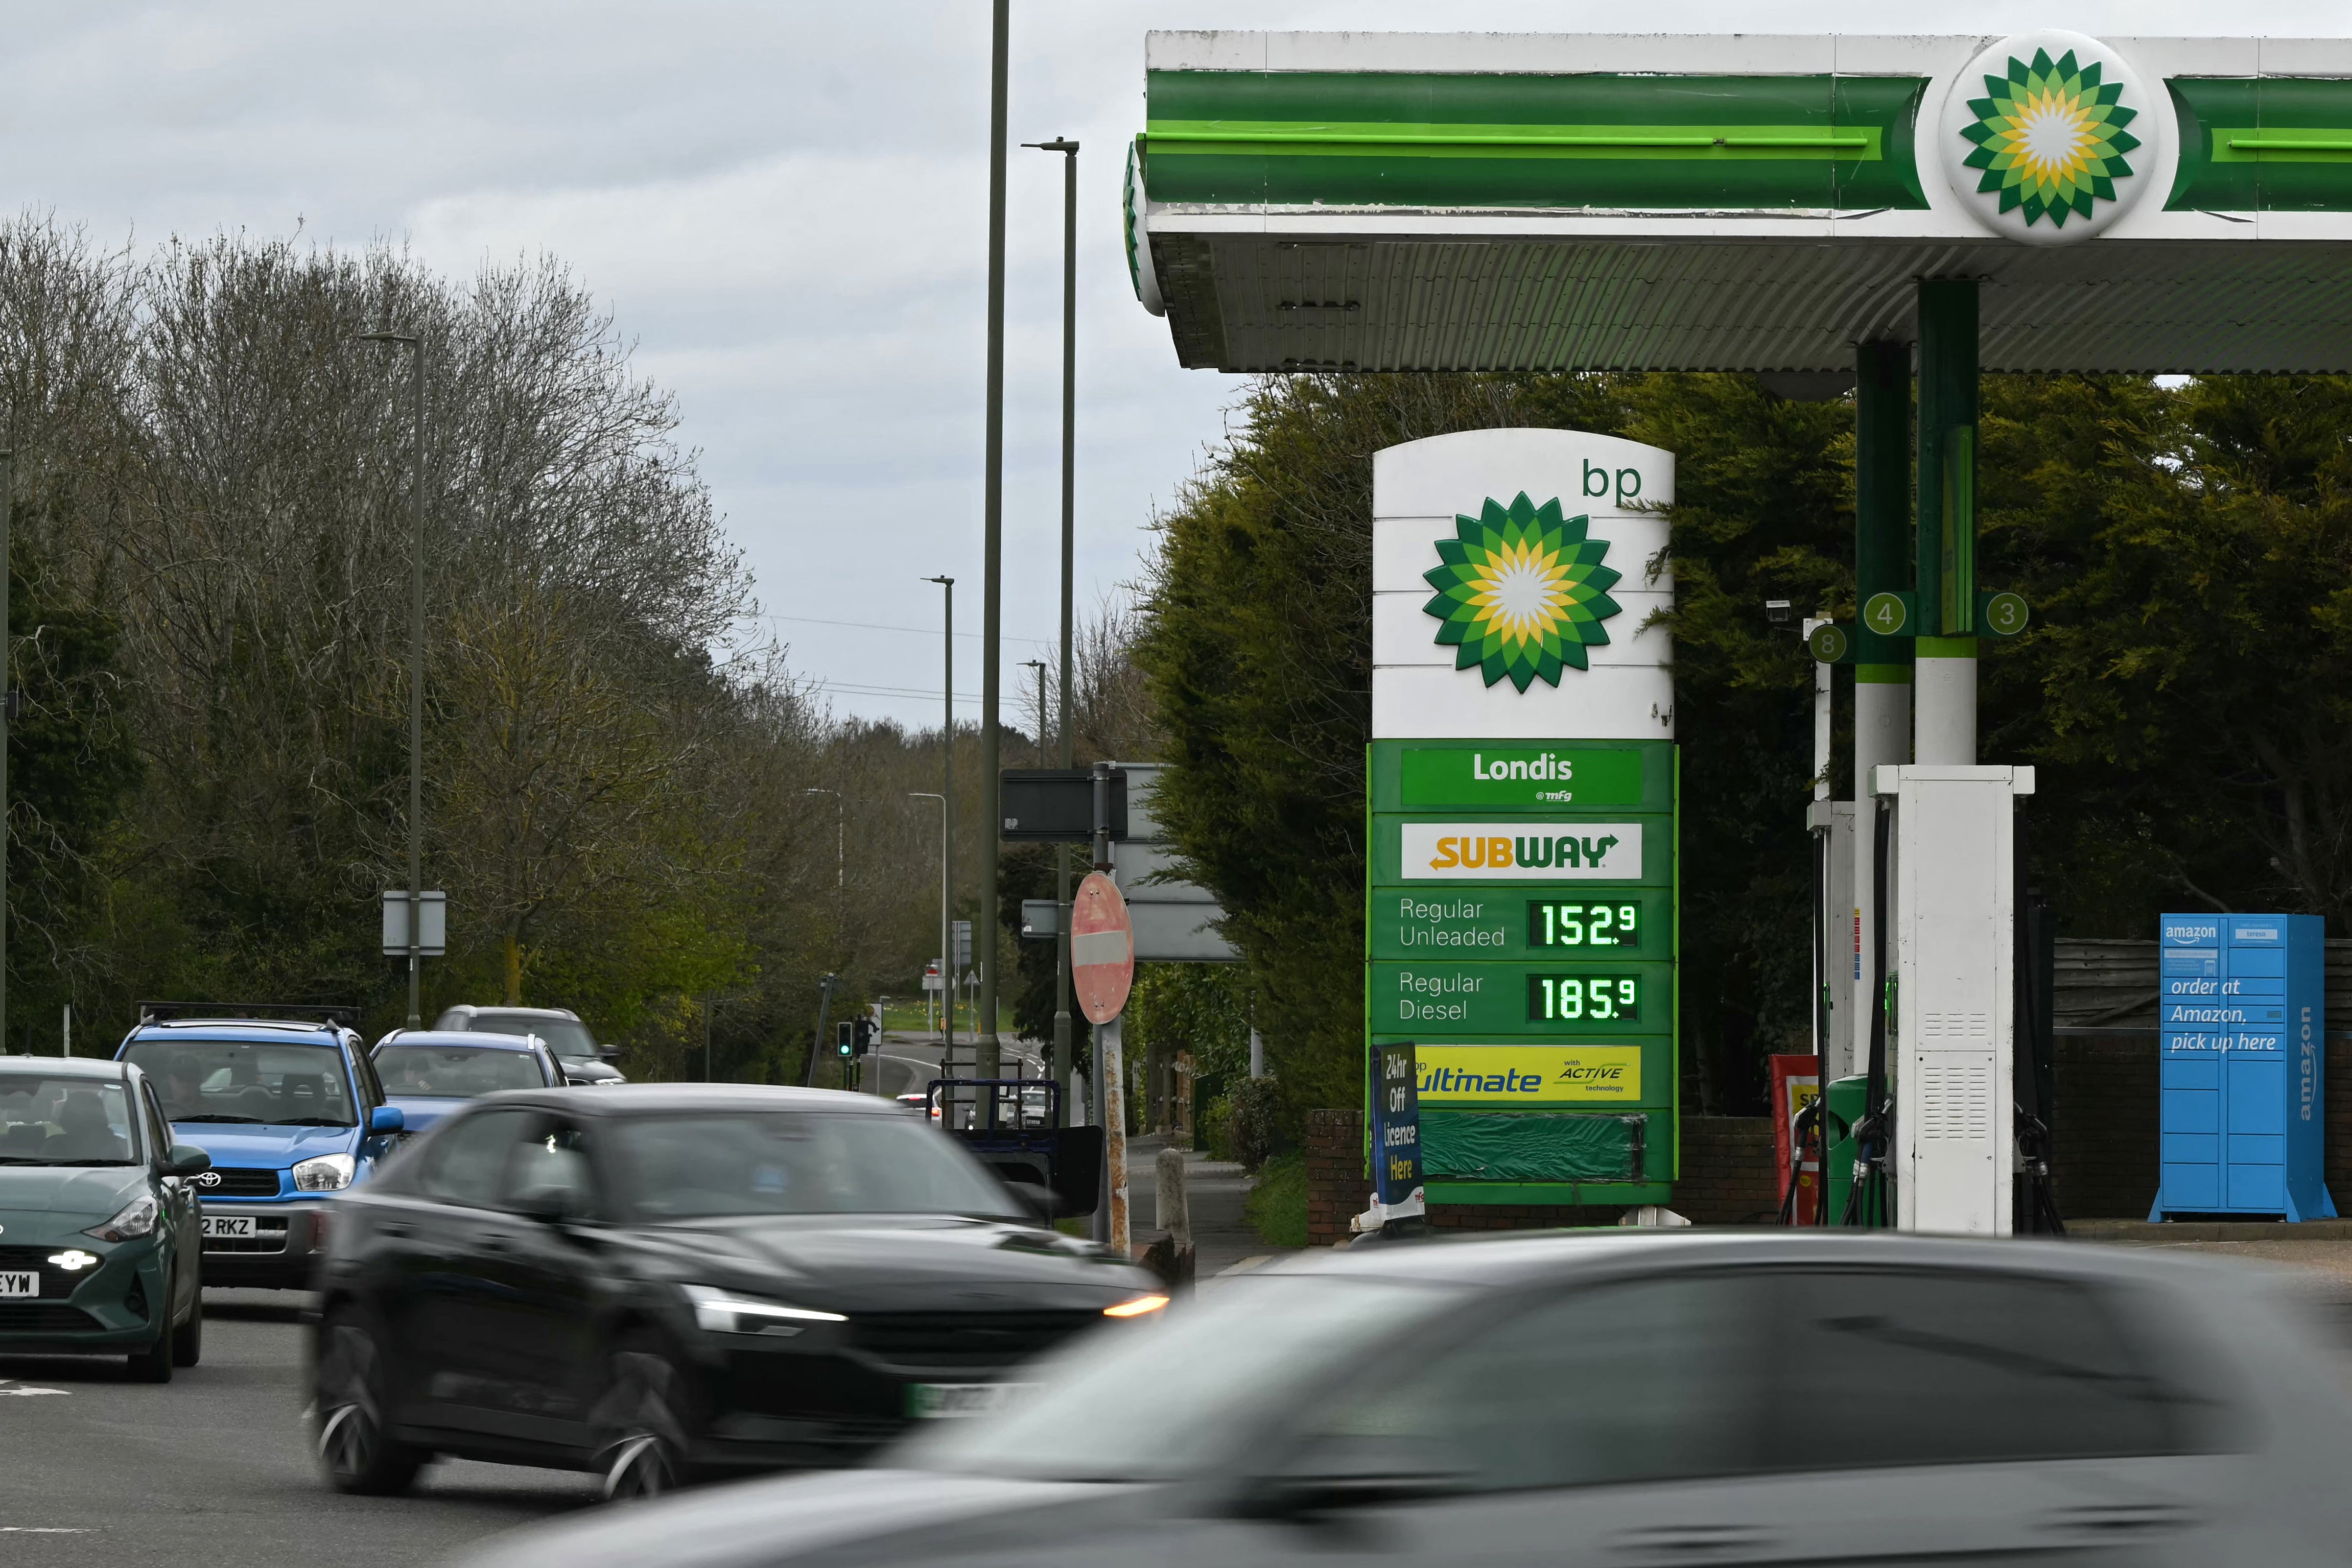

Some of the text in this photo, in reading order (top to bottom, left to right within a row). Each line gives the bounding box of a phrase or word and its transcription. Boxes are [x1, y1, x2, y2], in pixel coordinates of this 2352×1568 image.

[1583, 459, 1641, 507] bp
[1876, 603, 1893, 625] 4
[2000, 603, 2015, 625] 3
[1821, 634, 1834, 654] 8
[1474, 753, 1572, 780] Londis
[1429, 834, 1619, 871] SUBWAY
[1400, 898, 1484, 923] Regular
[1400, 926, 1504, 946] Unleaded
[2166, 926, 2216, 938] amazon
[1400, 972, 1483, 996] Regular
[2171, 978, 2241, 995] order at
[1400, 1000, 1466, 1020] Diesel
[2171, 1005, 2247, 1026] Amazon,
[2171, 1032, 2276, 1054] pick up here
[1386, 1053, 1407, 1080] 24hr
[1559, 1068, 1623, 1079] ACTIVE
[2301, 1006, 2312, 1121] amazon
[1417, 1067, 1542, 1092] ultimate
[1586, 1084, 1624, 1092] technology
[1390, 1087, 1405, 1112] Off
[1384, 1122, 1416, 1147] Licence
[1391, 1155, 1413, 1181] Here
[216, 1219, 249, 1235] RKZ
